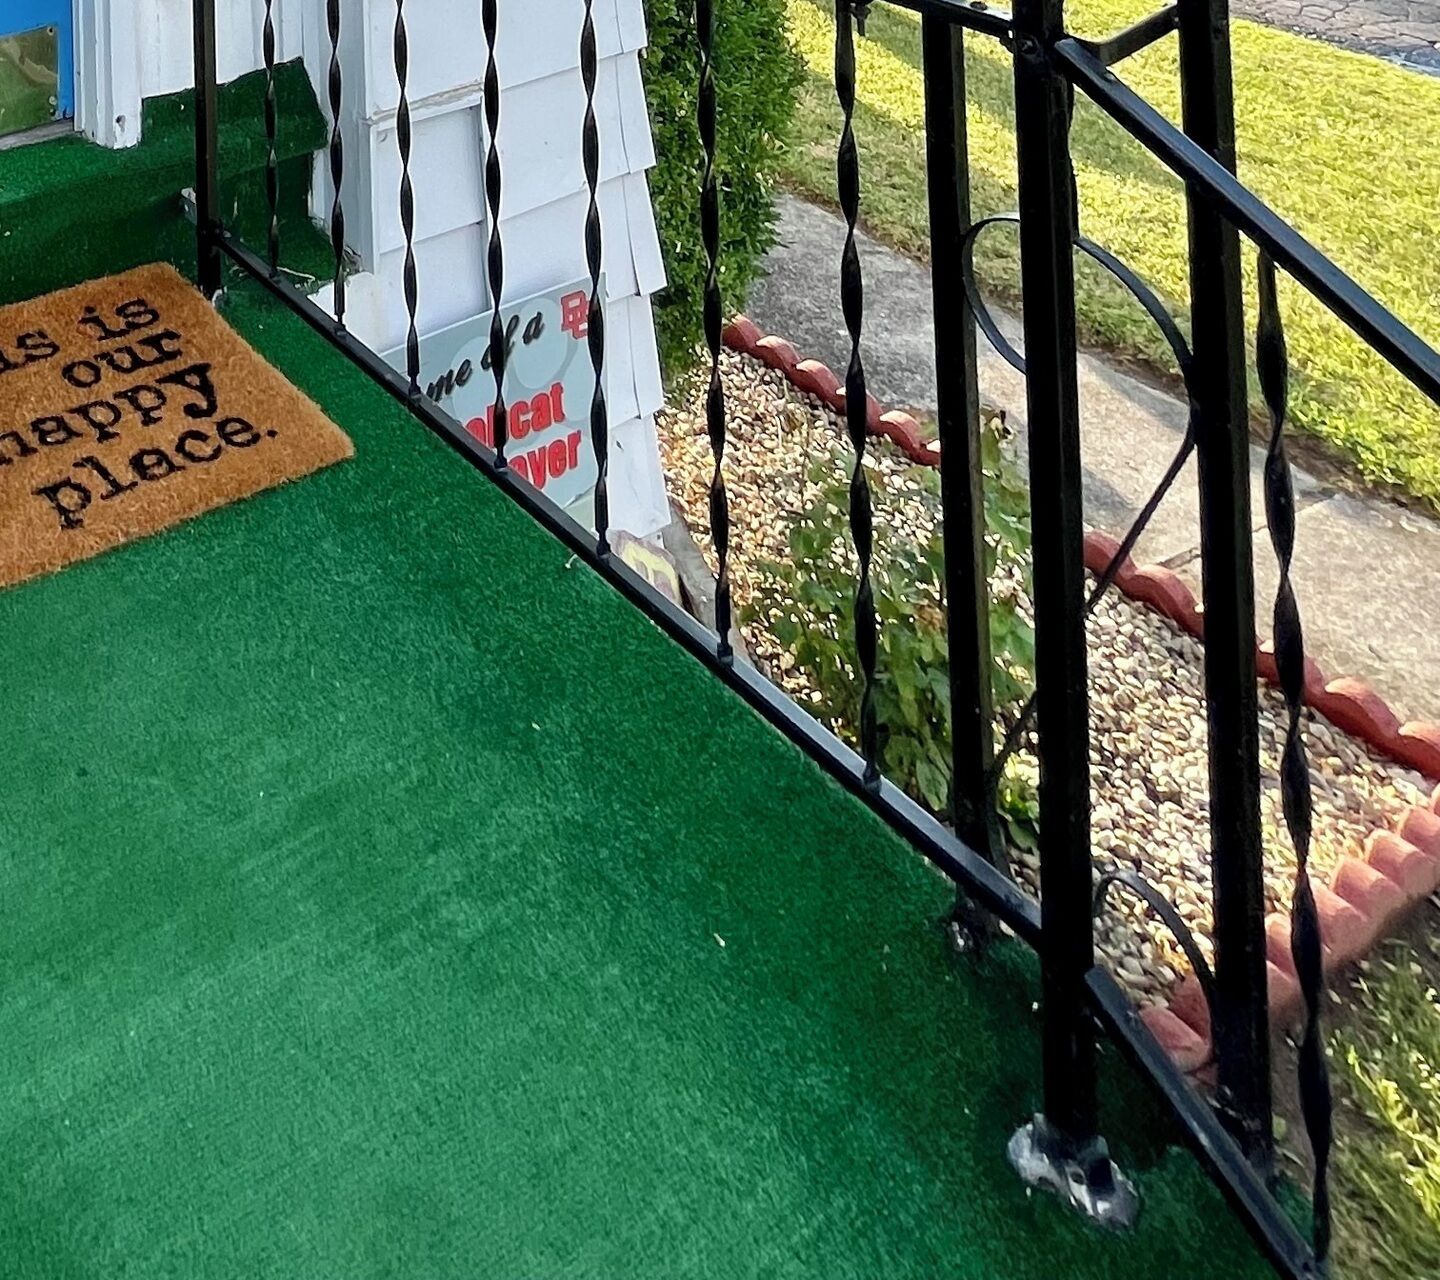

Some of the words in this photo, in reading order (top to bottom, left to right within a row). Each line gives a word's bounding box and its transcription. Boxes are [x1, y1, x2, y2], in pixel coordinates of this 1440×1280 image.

[77, 297, 162, 342] is
[61, 328, 184, 389] our
[31, 414, 279, 530] place.
